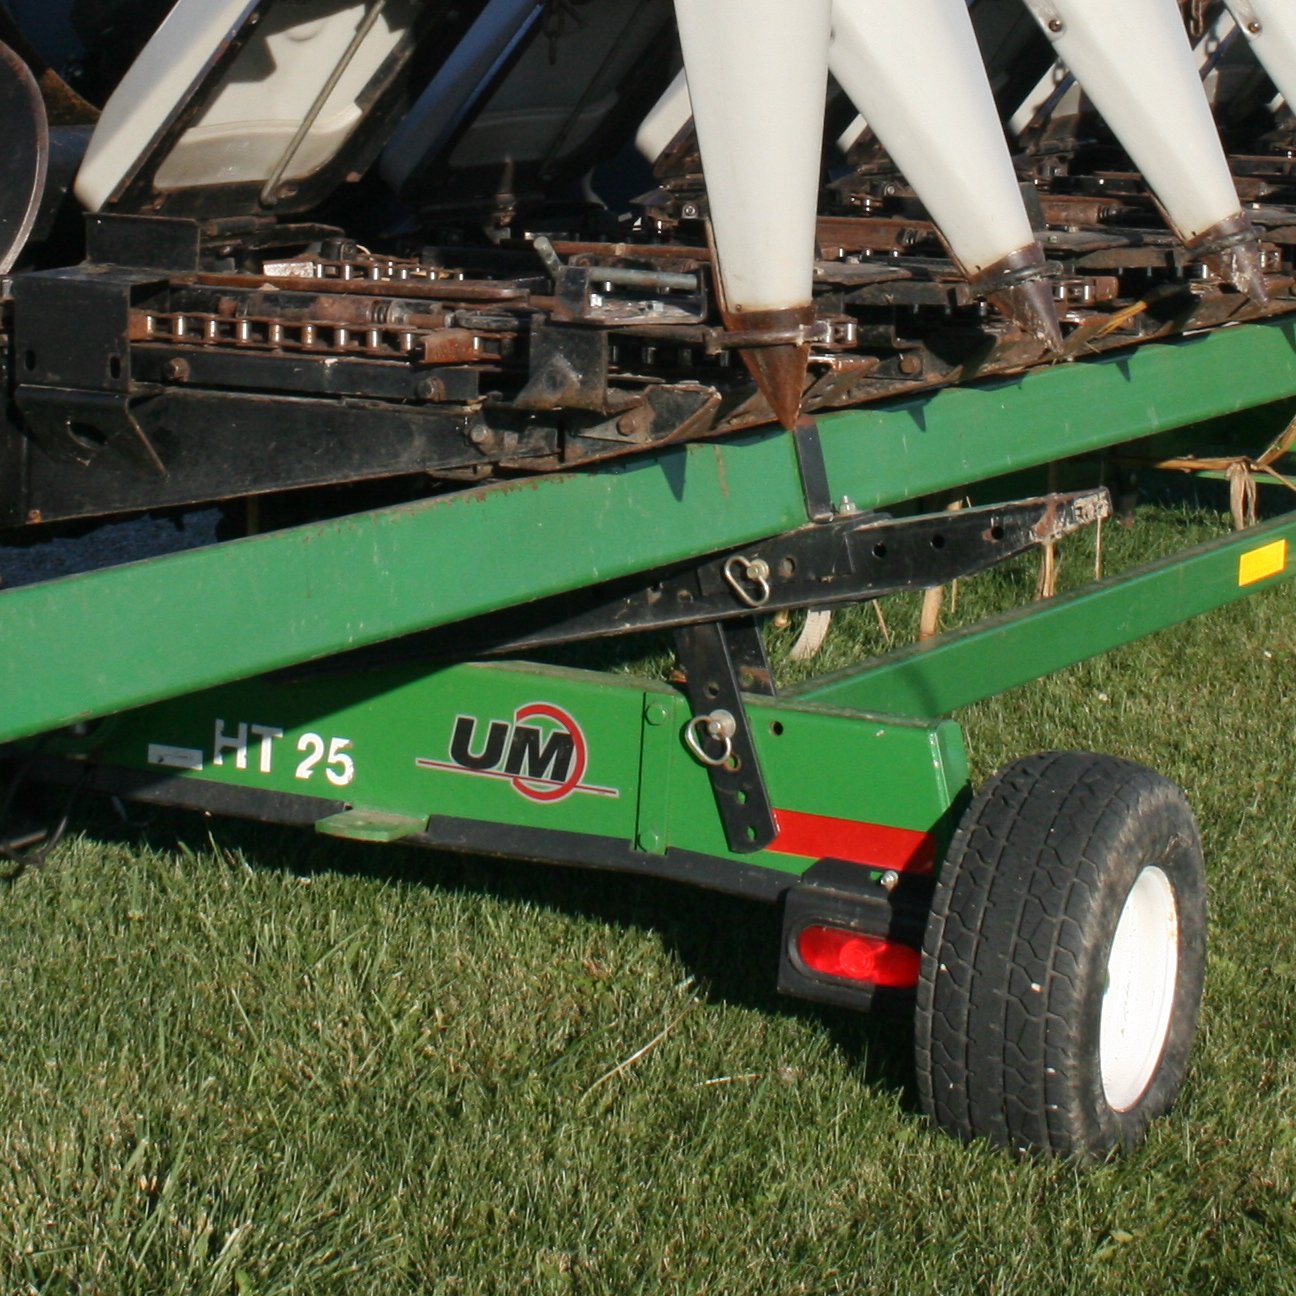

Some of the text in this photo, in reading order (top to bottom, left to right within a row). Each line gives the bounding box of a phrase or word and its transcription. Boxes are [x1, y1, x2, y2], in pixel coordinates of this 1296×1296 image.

[212, 718, 356, 787] HT 25
[450, 716, 576, 783] UM
